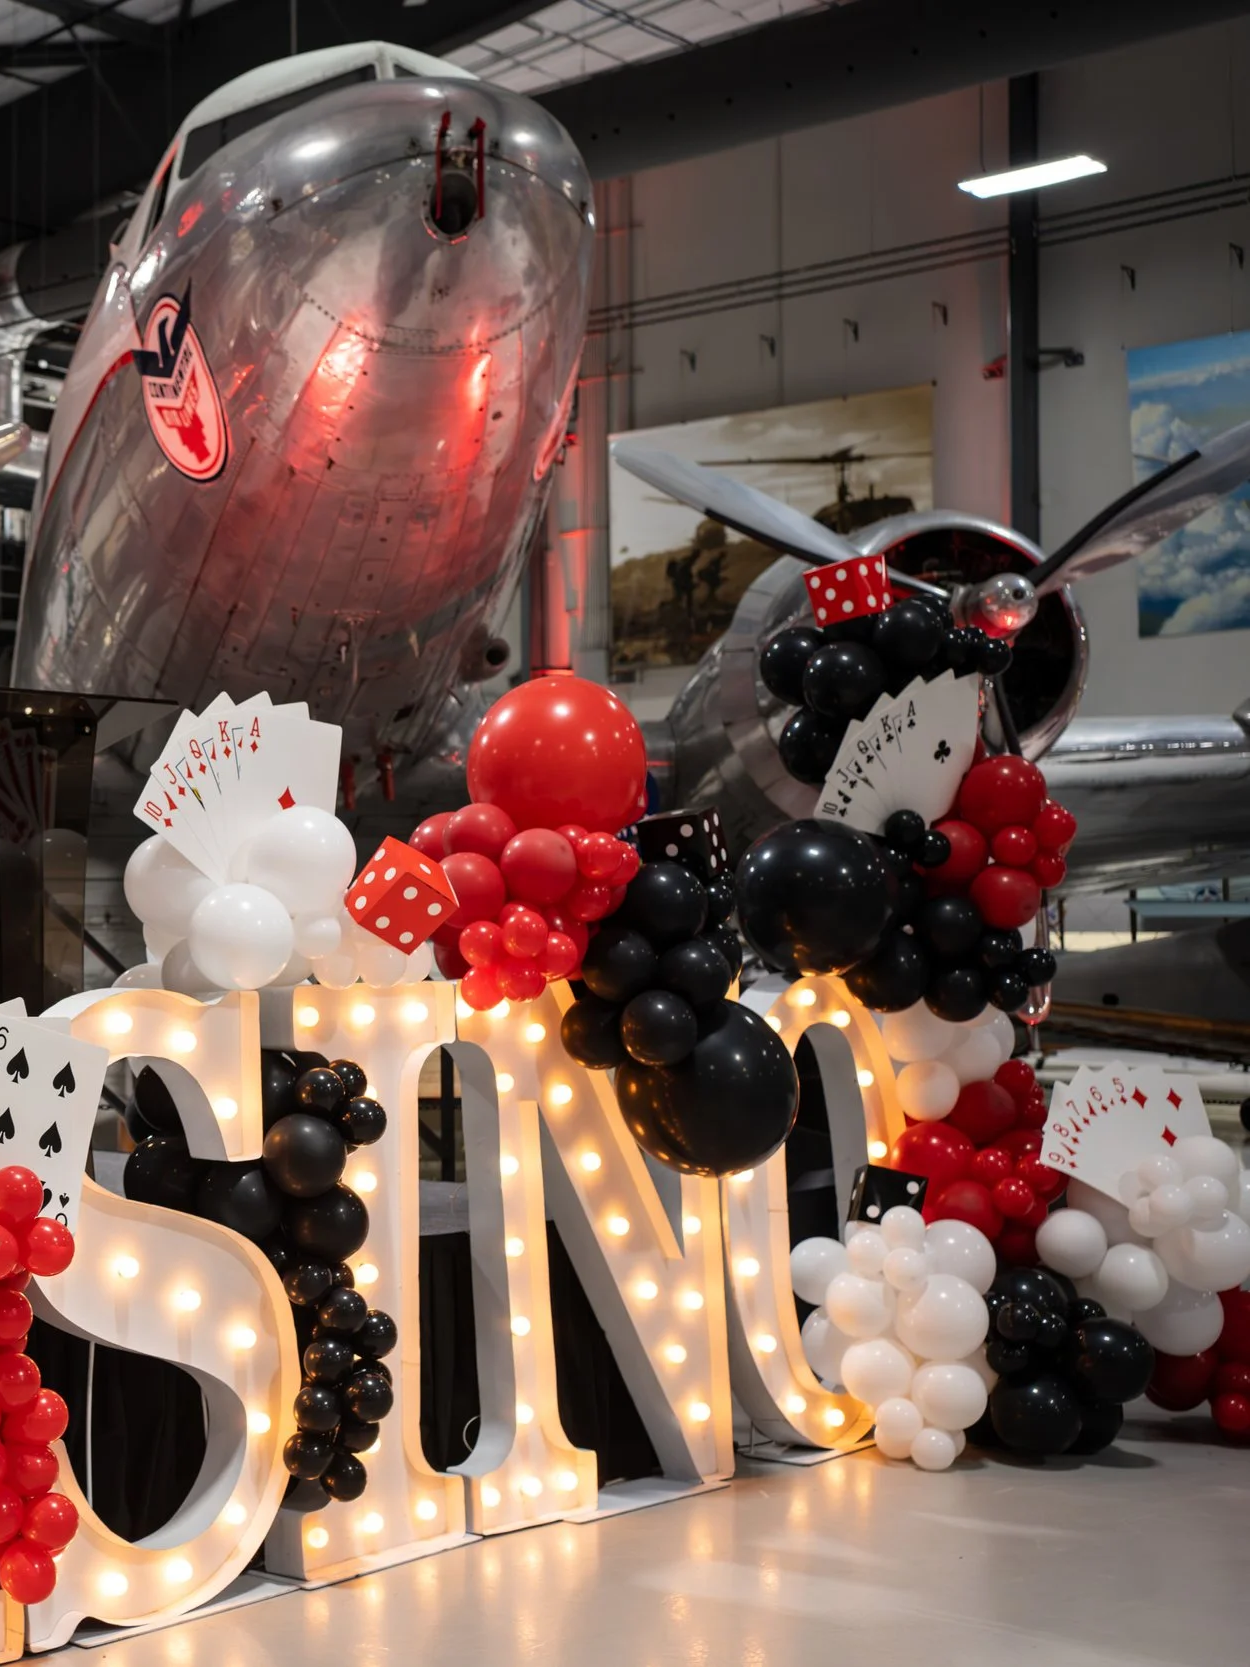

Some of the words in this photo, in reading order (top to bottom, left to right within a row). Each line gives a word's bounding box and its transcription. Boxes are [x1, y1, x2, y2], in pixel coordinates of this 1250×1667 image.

[822, 801, 838, 815] 10
[836, 768, 849, 784] J
[857, 740, 869, 755] Q
[880, 714, 892, 733] K
[907, 700, 916, 717] A
[143, 801, 163, 821] 10
[163, 763, 177, 785] J
[189, 739, 203, 759] Q
[218, 720, 231, 742] K
[249, 716, 261, 738] A
[1089, 1086, 1103, 1101] 6
[1112, 1077, 1125, 1094] 5
[1066, 1100, 1080, 1116] 7
[1052, 1123, 1069, 1138] 8
[1048, 1151, 1065, 1165] 9
